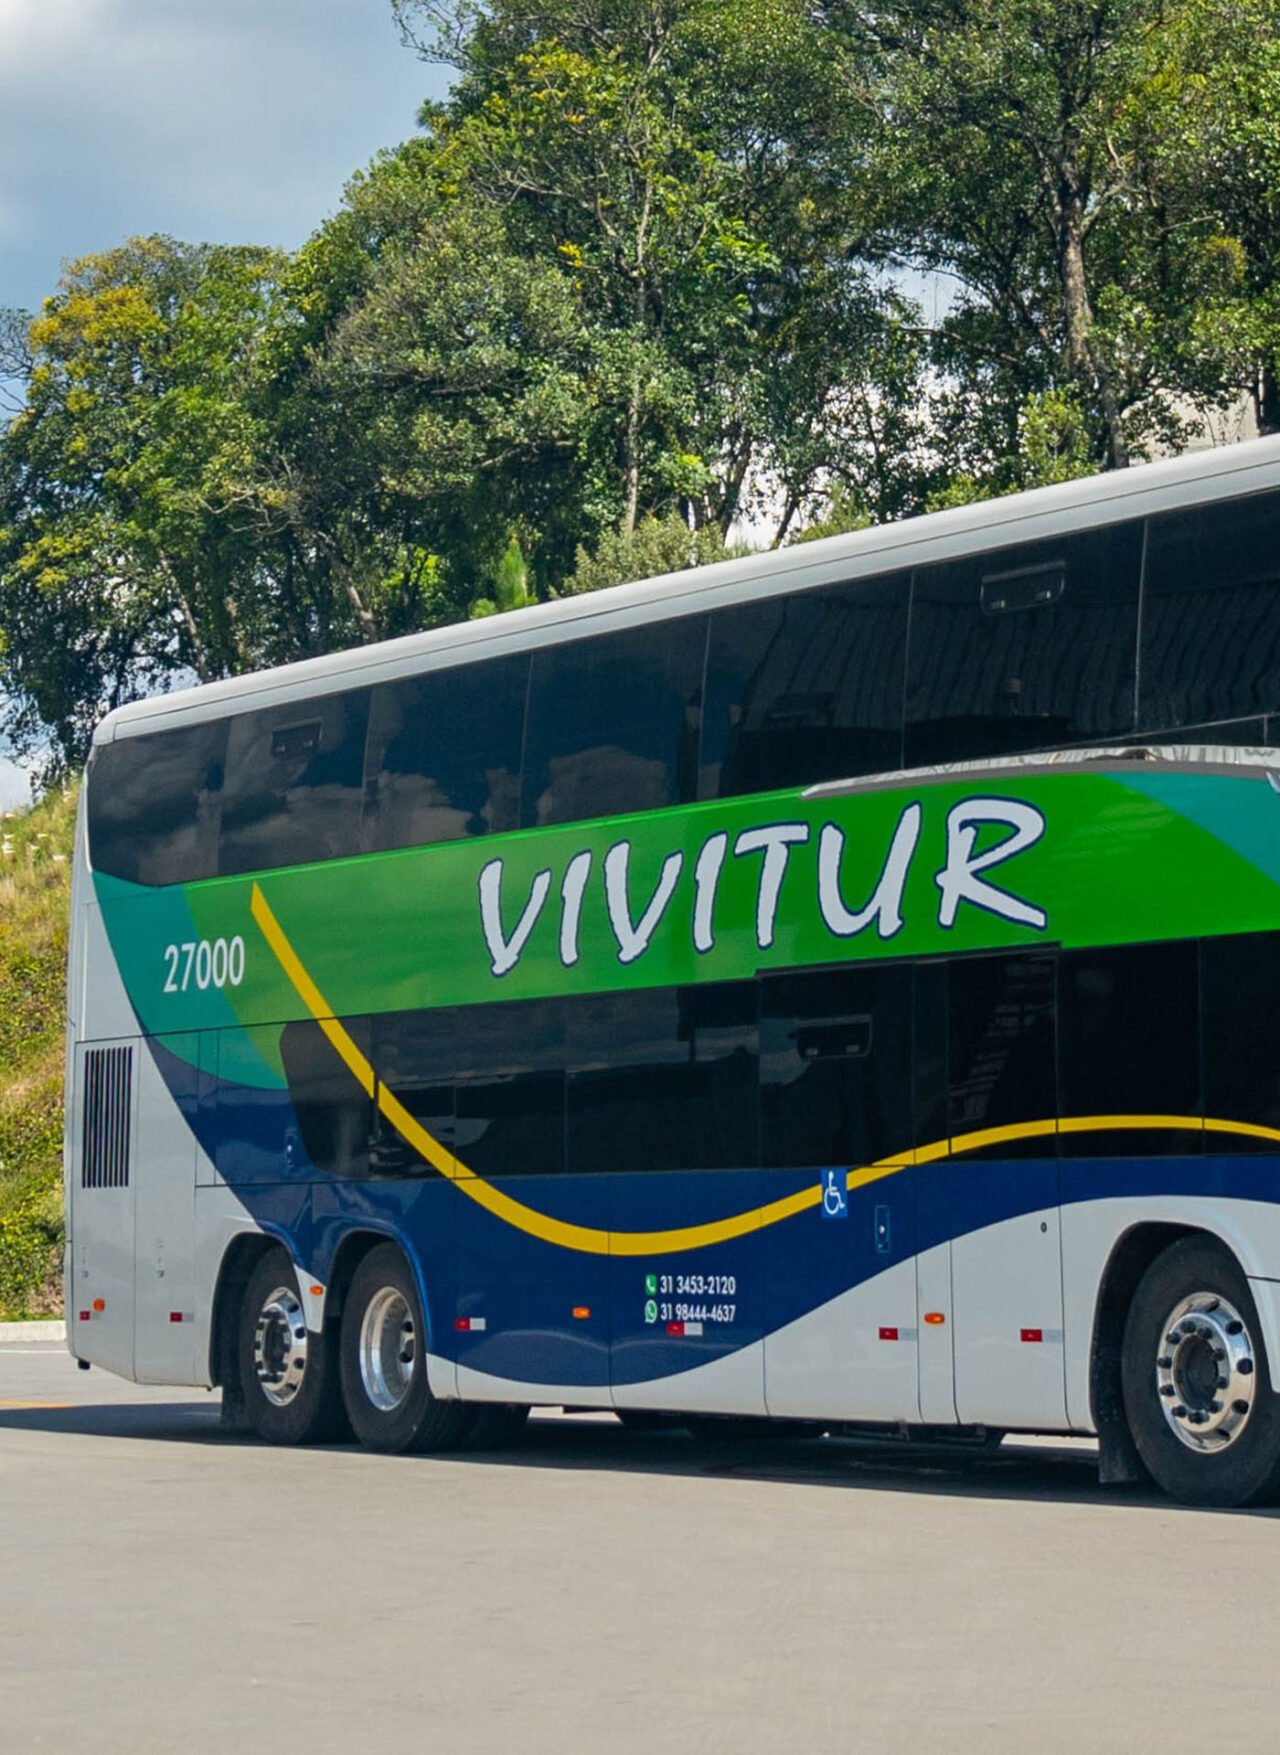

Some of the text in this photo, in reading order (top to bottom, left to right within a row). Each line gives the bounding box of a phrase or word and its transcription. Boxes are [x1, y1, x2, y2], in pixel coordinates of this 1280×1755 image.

[478, 796, 1047, 977] VIVITUR
[163, 935, 246, 993] 27000
[660, 1275, 736, 1295] 31 3453-2120
[660, 1303, 736, 1322] 31 98444-4637
